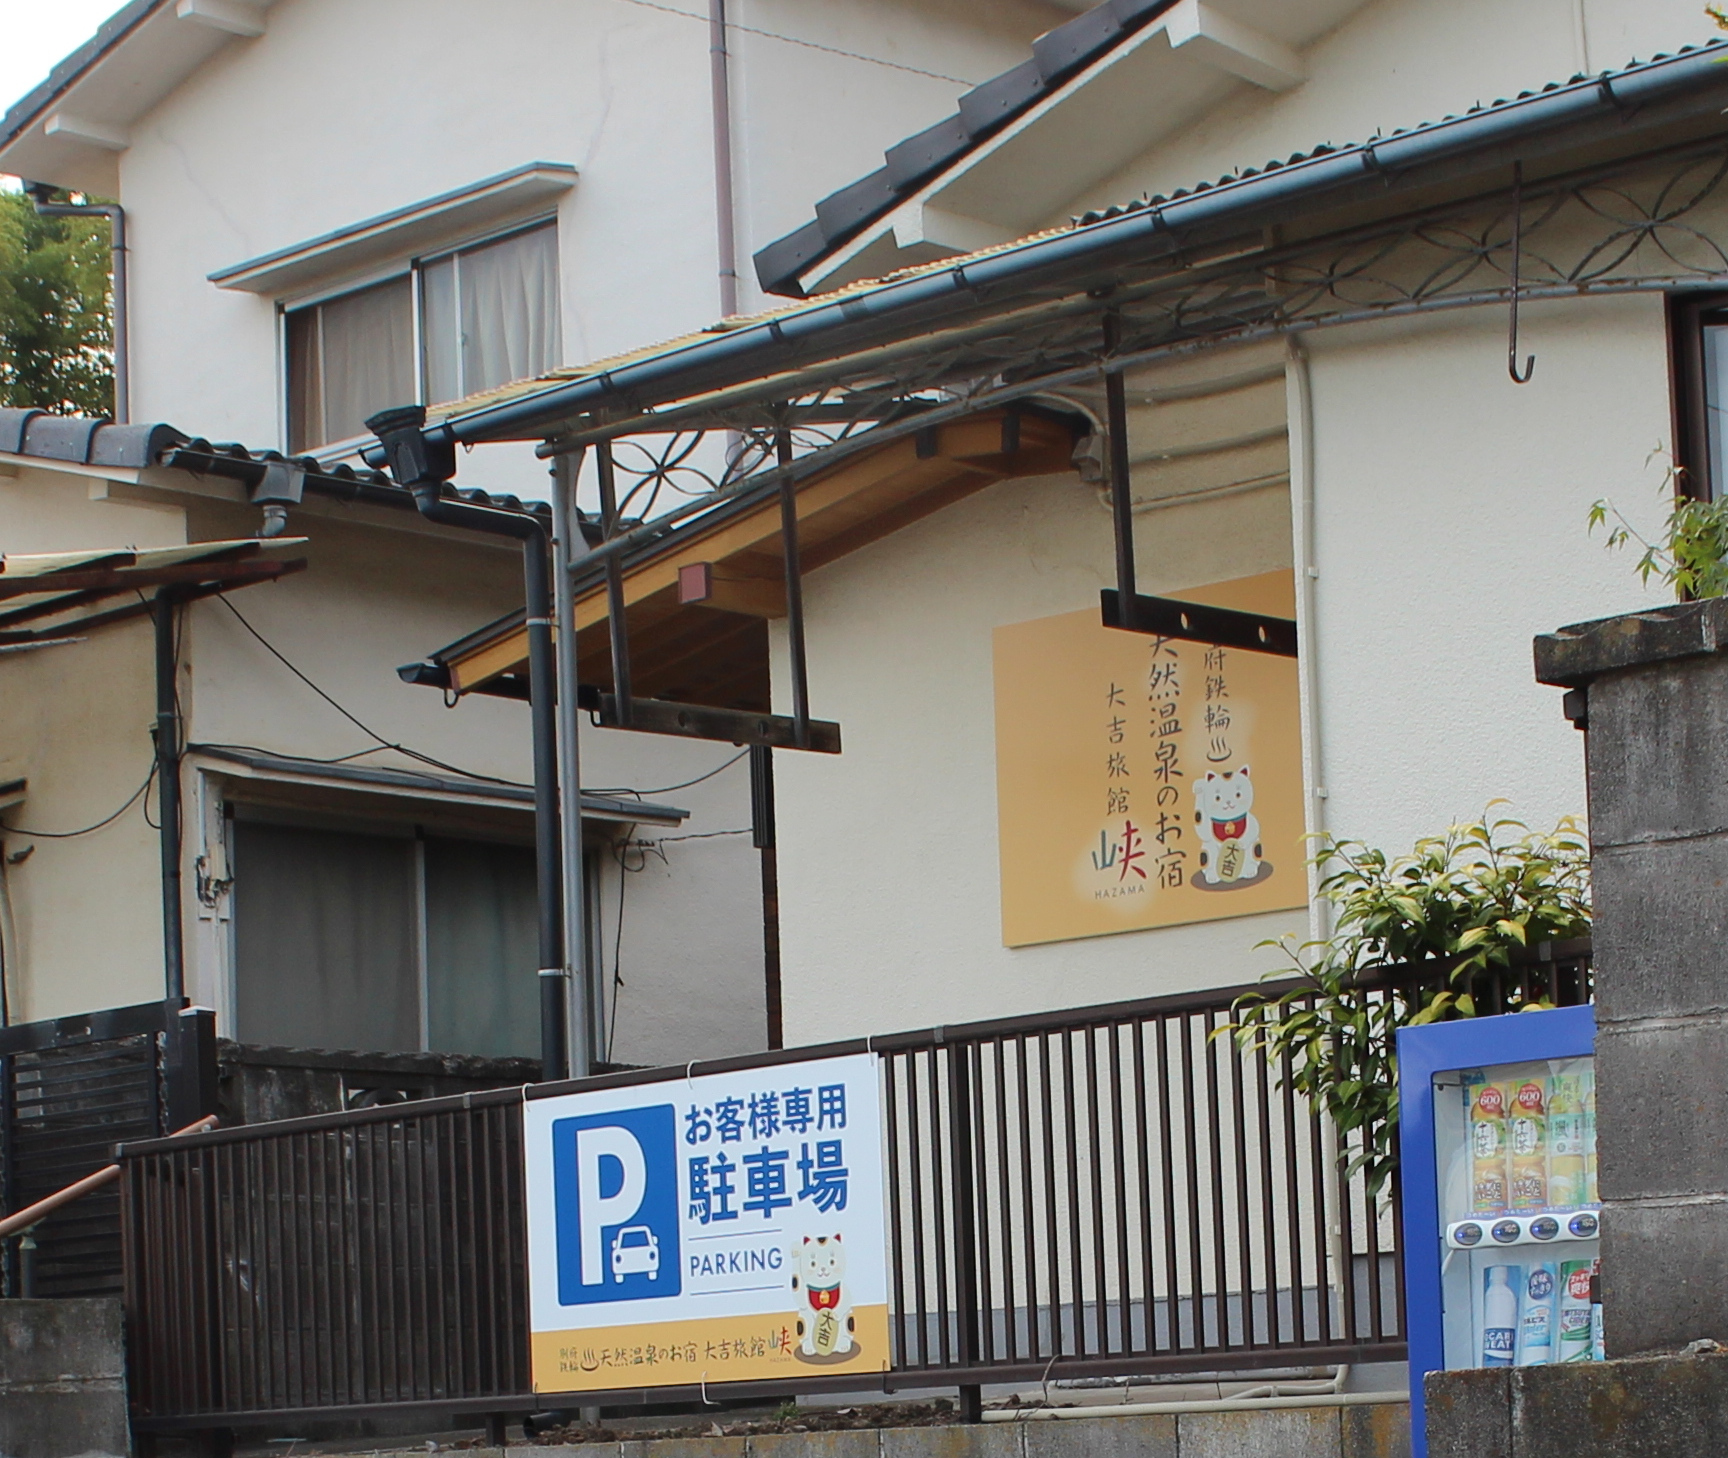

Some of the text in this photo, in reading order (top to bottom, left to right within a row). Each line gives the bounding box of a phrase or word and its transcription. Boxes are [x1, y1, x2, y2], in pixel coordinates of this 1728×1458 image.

[1105, 682, 1130, 816] 大吉旅館
[1092, 819, 1147, 882] 峡
[1220, 842, 1240, 878] 大吉
[1094, 884, 1145, 900] HAZAMA
[1480, 1096, 1501, 1106] 600
[1519, 1091, 1540, 1100] 600
[684, 1083, 848, 1145] お客様専用
[688, 1139, 850, 1225] 駐車場
[576, 1125, 647, 1287] P
[690, 1247, 783, 1277] PARKING
[817, 1311, 834, 1347] 大吉
[600, 1341, 698, 1367] 天然温泉のお宿
[704, 1336, 766, 1360] 大吉旅館
